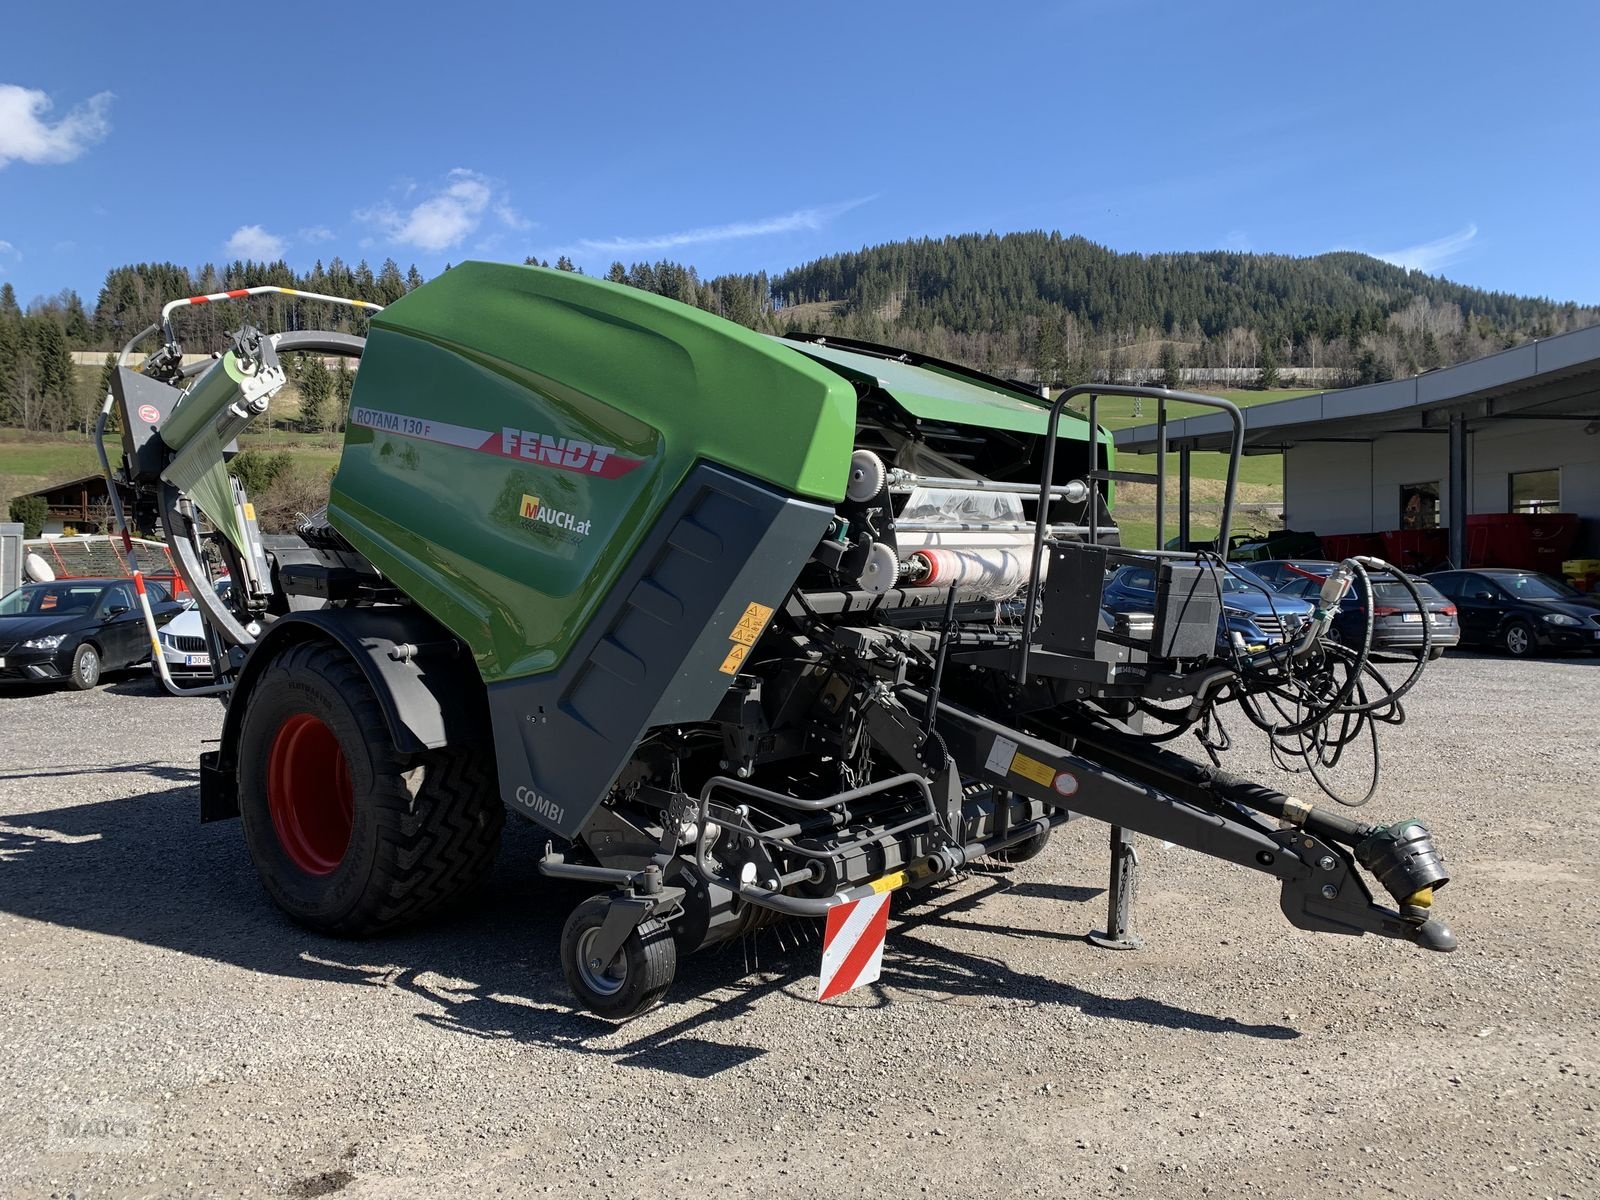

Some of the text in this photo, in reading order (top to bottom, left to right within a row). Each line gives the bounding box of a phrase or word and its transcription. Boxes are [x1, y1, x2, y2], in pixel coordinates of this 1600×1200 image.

[356, 409, 431, 436] ROTANA 130 F
[502, 426, 616, 473] FENDT
[525, 502, 592, 536] MAUCH.at
[515, 785, 565, 824] COMBI
